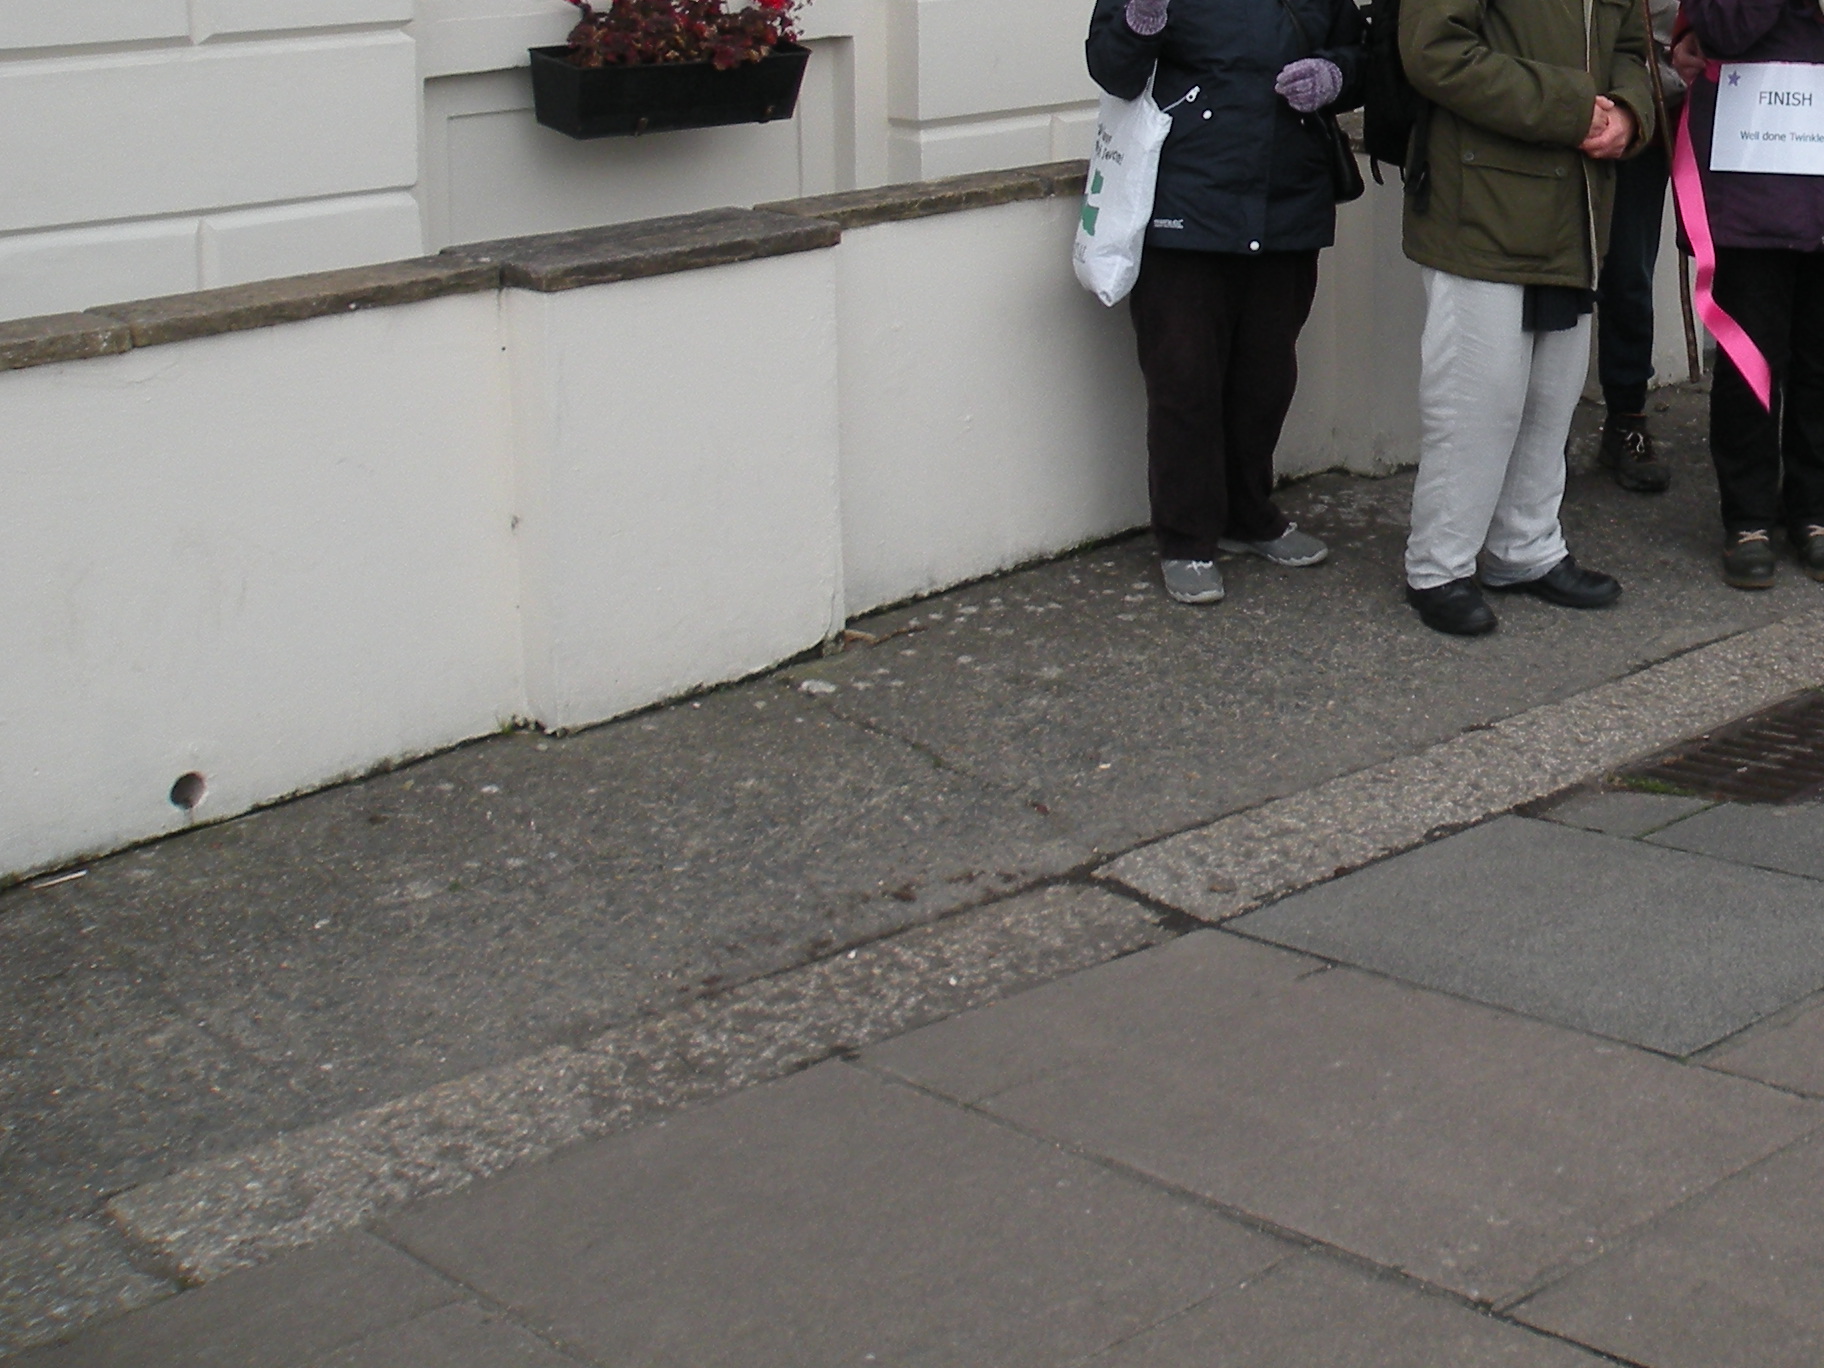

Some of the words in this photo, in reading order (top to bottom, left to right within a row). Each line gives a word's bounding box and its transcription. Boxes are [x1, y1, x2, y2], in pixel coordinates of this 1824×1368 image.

[1758, 91, 1813, 107] FINISH
[1740, 130, 1760, 141] Well
[1762, 131, 1787, 142] done
